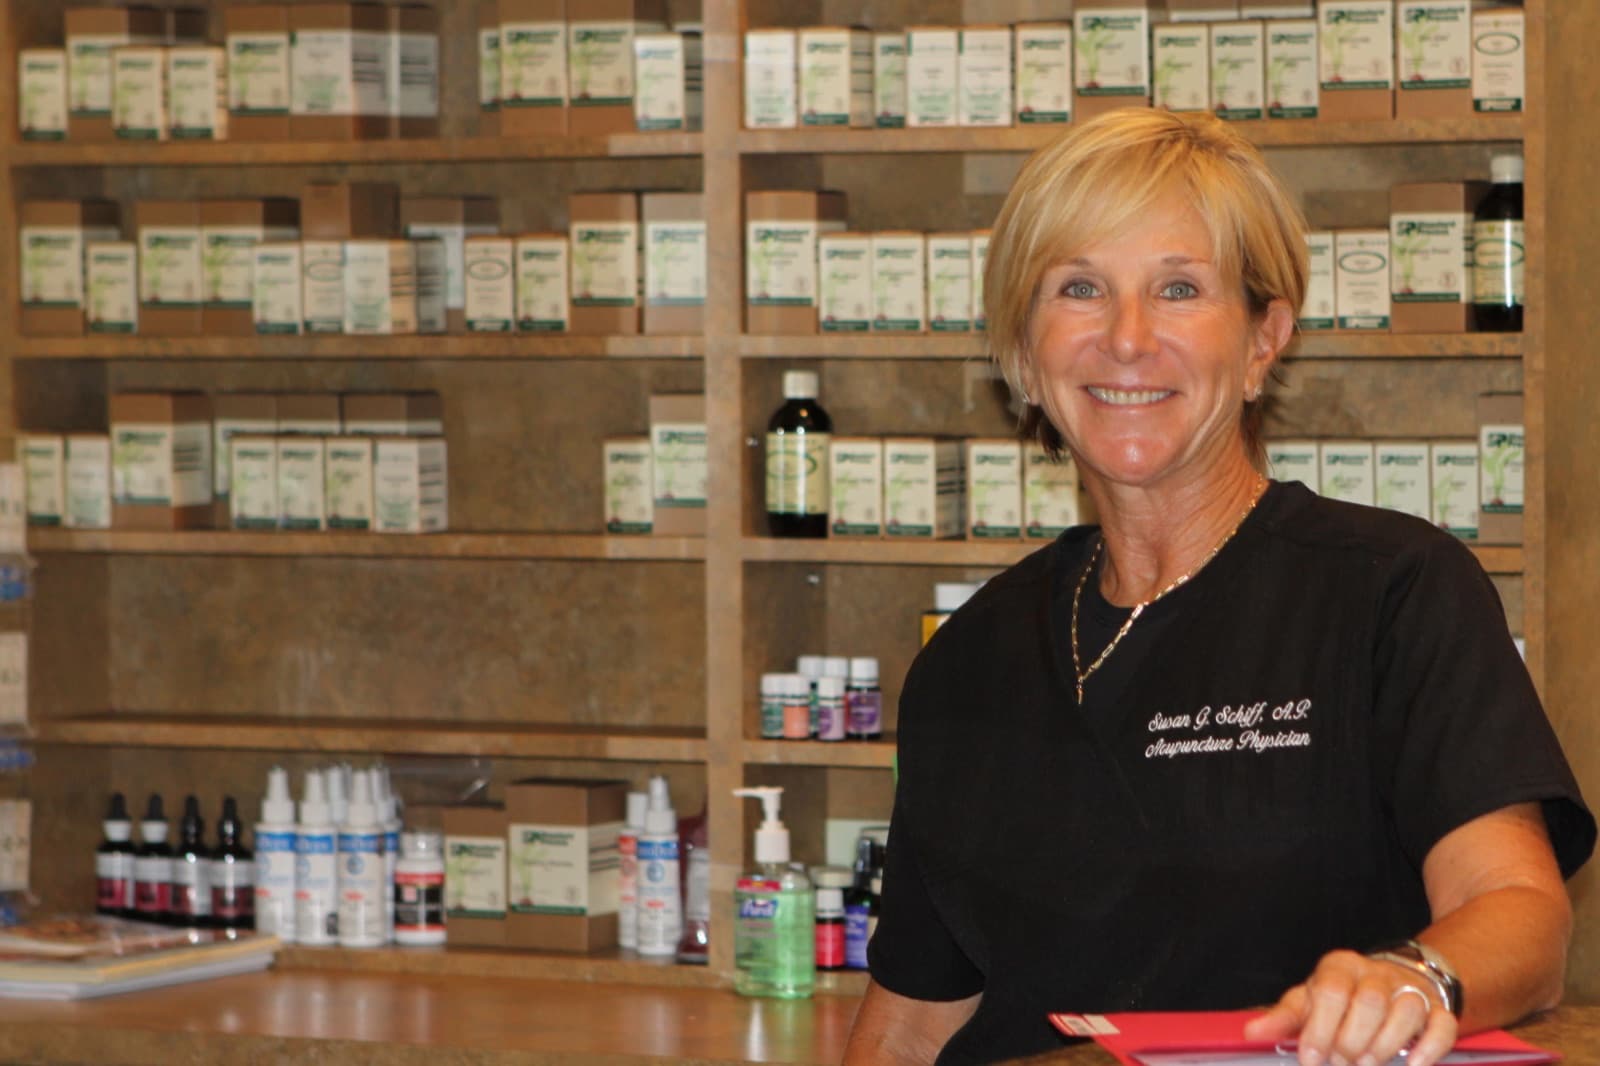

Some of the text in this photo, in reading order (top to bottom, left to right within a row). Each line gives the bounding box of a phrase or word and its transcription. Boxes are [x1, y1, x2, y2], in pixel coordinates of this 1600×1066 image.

[1148, 712, 1191, 732] Susan
[1145, 729, 1311, 758] Acupuncture Physician
